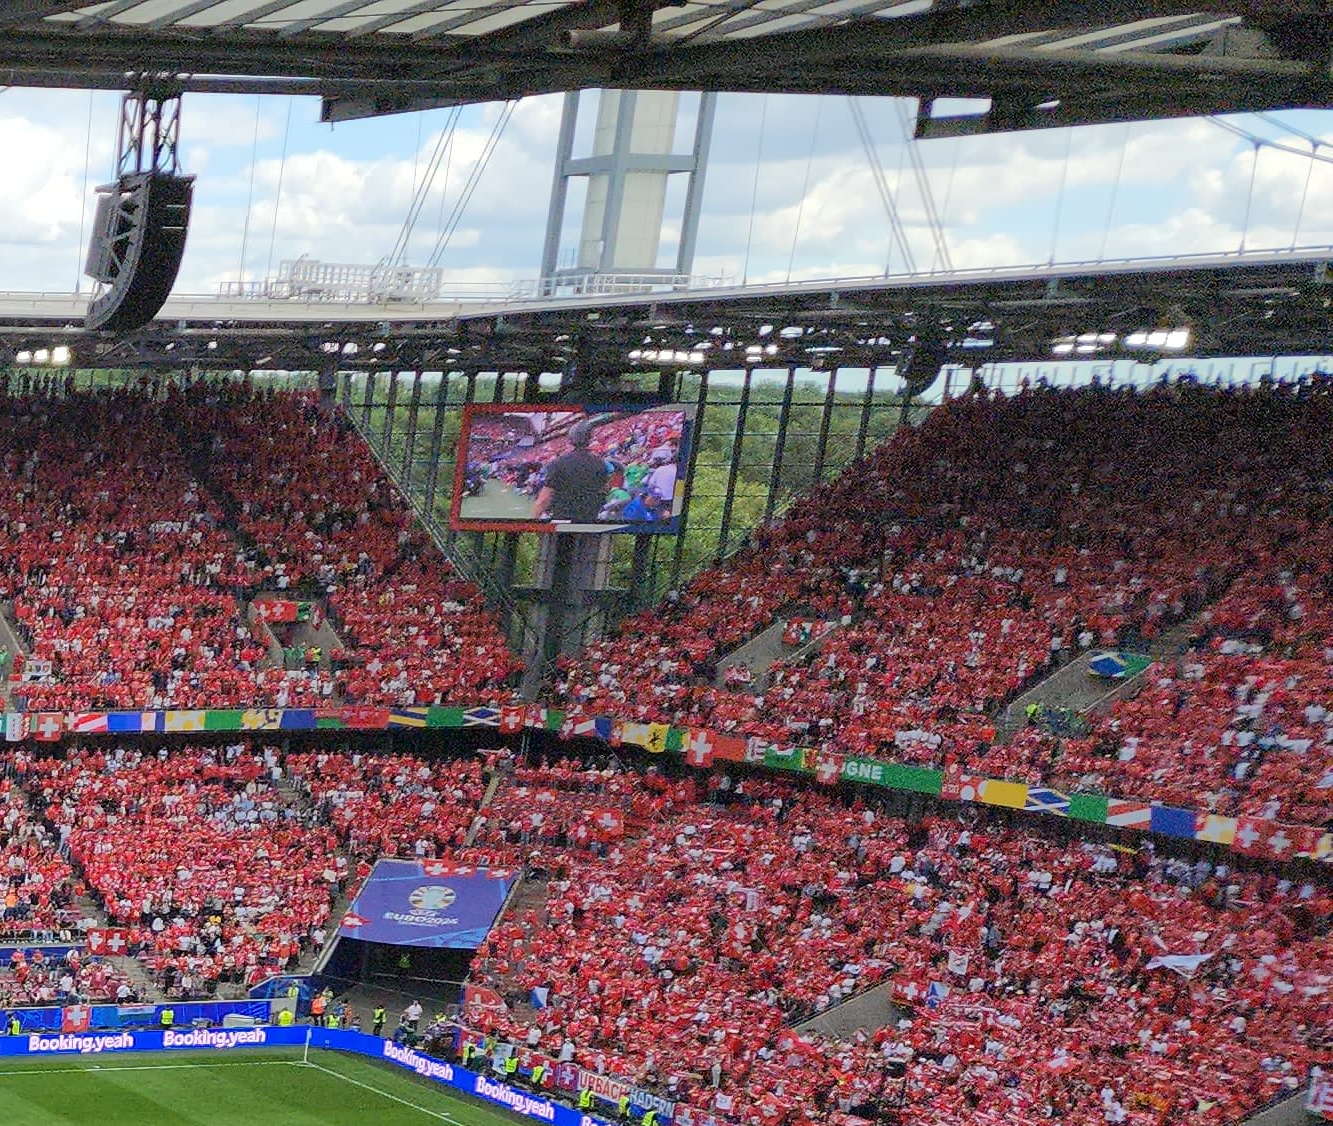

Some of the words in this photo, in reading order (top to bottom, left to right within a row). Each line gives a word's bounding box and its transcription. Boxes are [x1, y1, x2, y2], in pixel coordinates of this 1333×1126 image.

[28, 1031, 134, 1053] Booking.yeah
[163, 1026, 267, 1048] Booking.yeah
[383, 1041, 454, 1080] Booking.yeah
[476, 1077, 555, 1120] Booking.yeah
